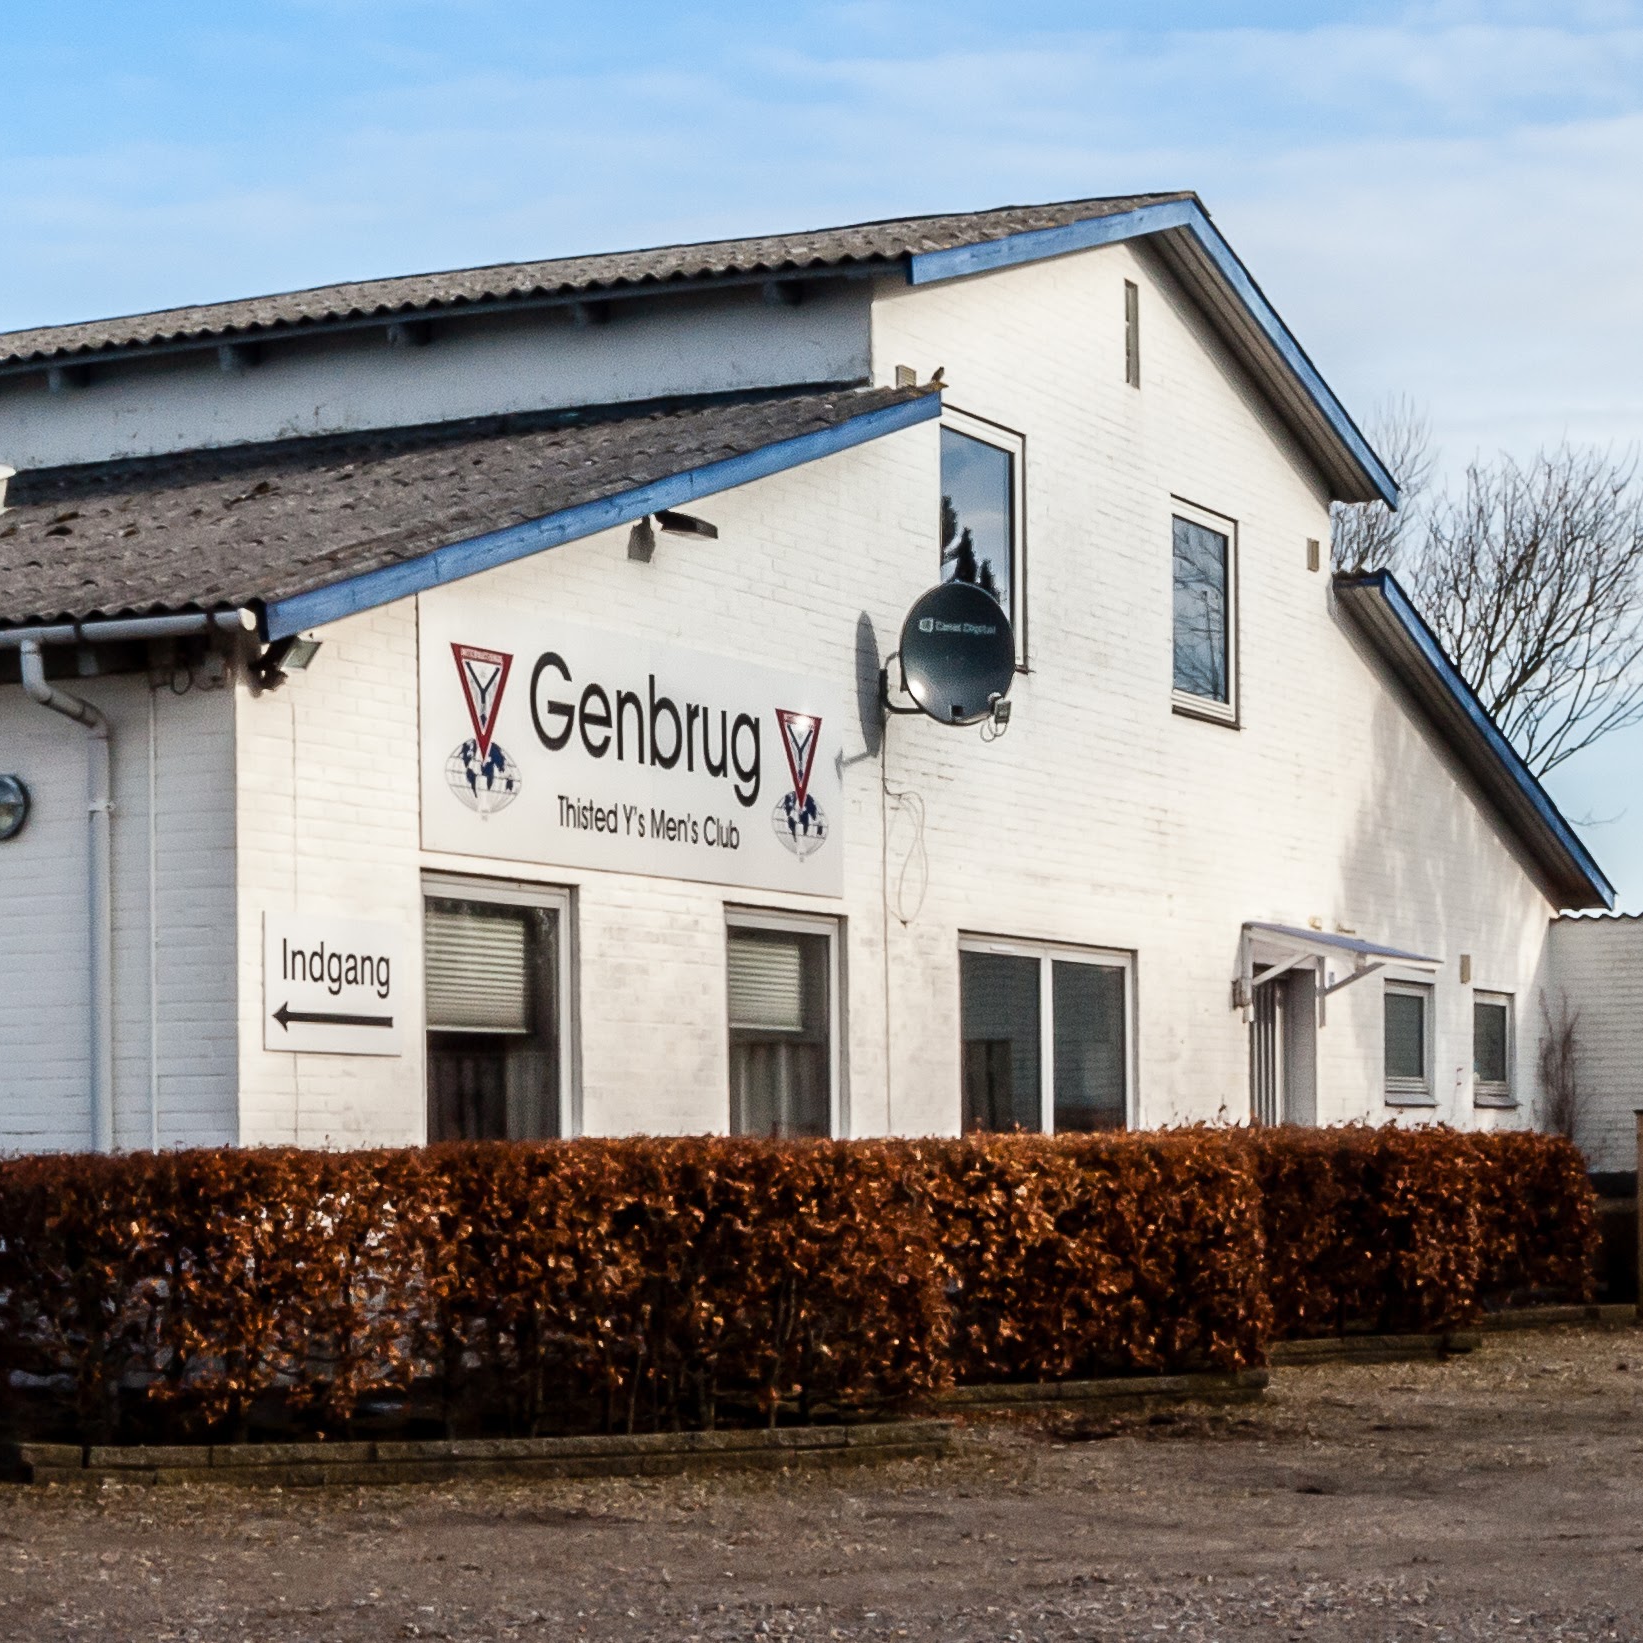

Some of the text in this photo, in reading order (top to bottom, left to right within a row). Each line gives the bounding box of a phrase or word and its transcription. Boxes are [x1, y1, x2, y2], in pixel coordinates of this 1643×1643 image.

[530, 651, 761, 807] Genbrug
[557, 795, 741, 850] Thisted Y's Men's Club
[282, 938, 391, 999] Indgang
